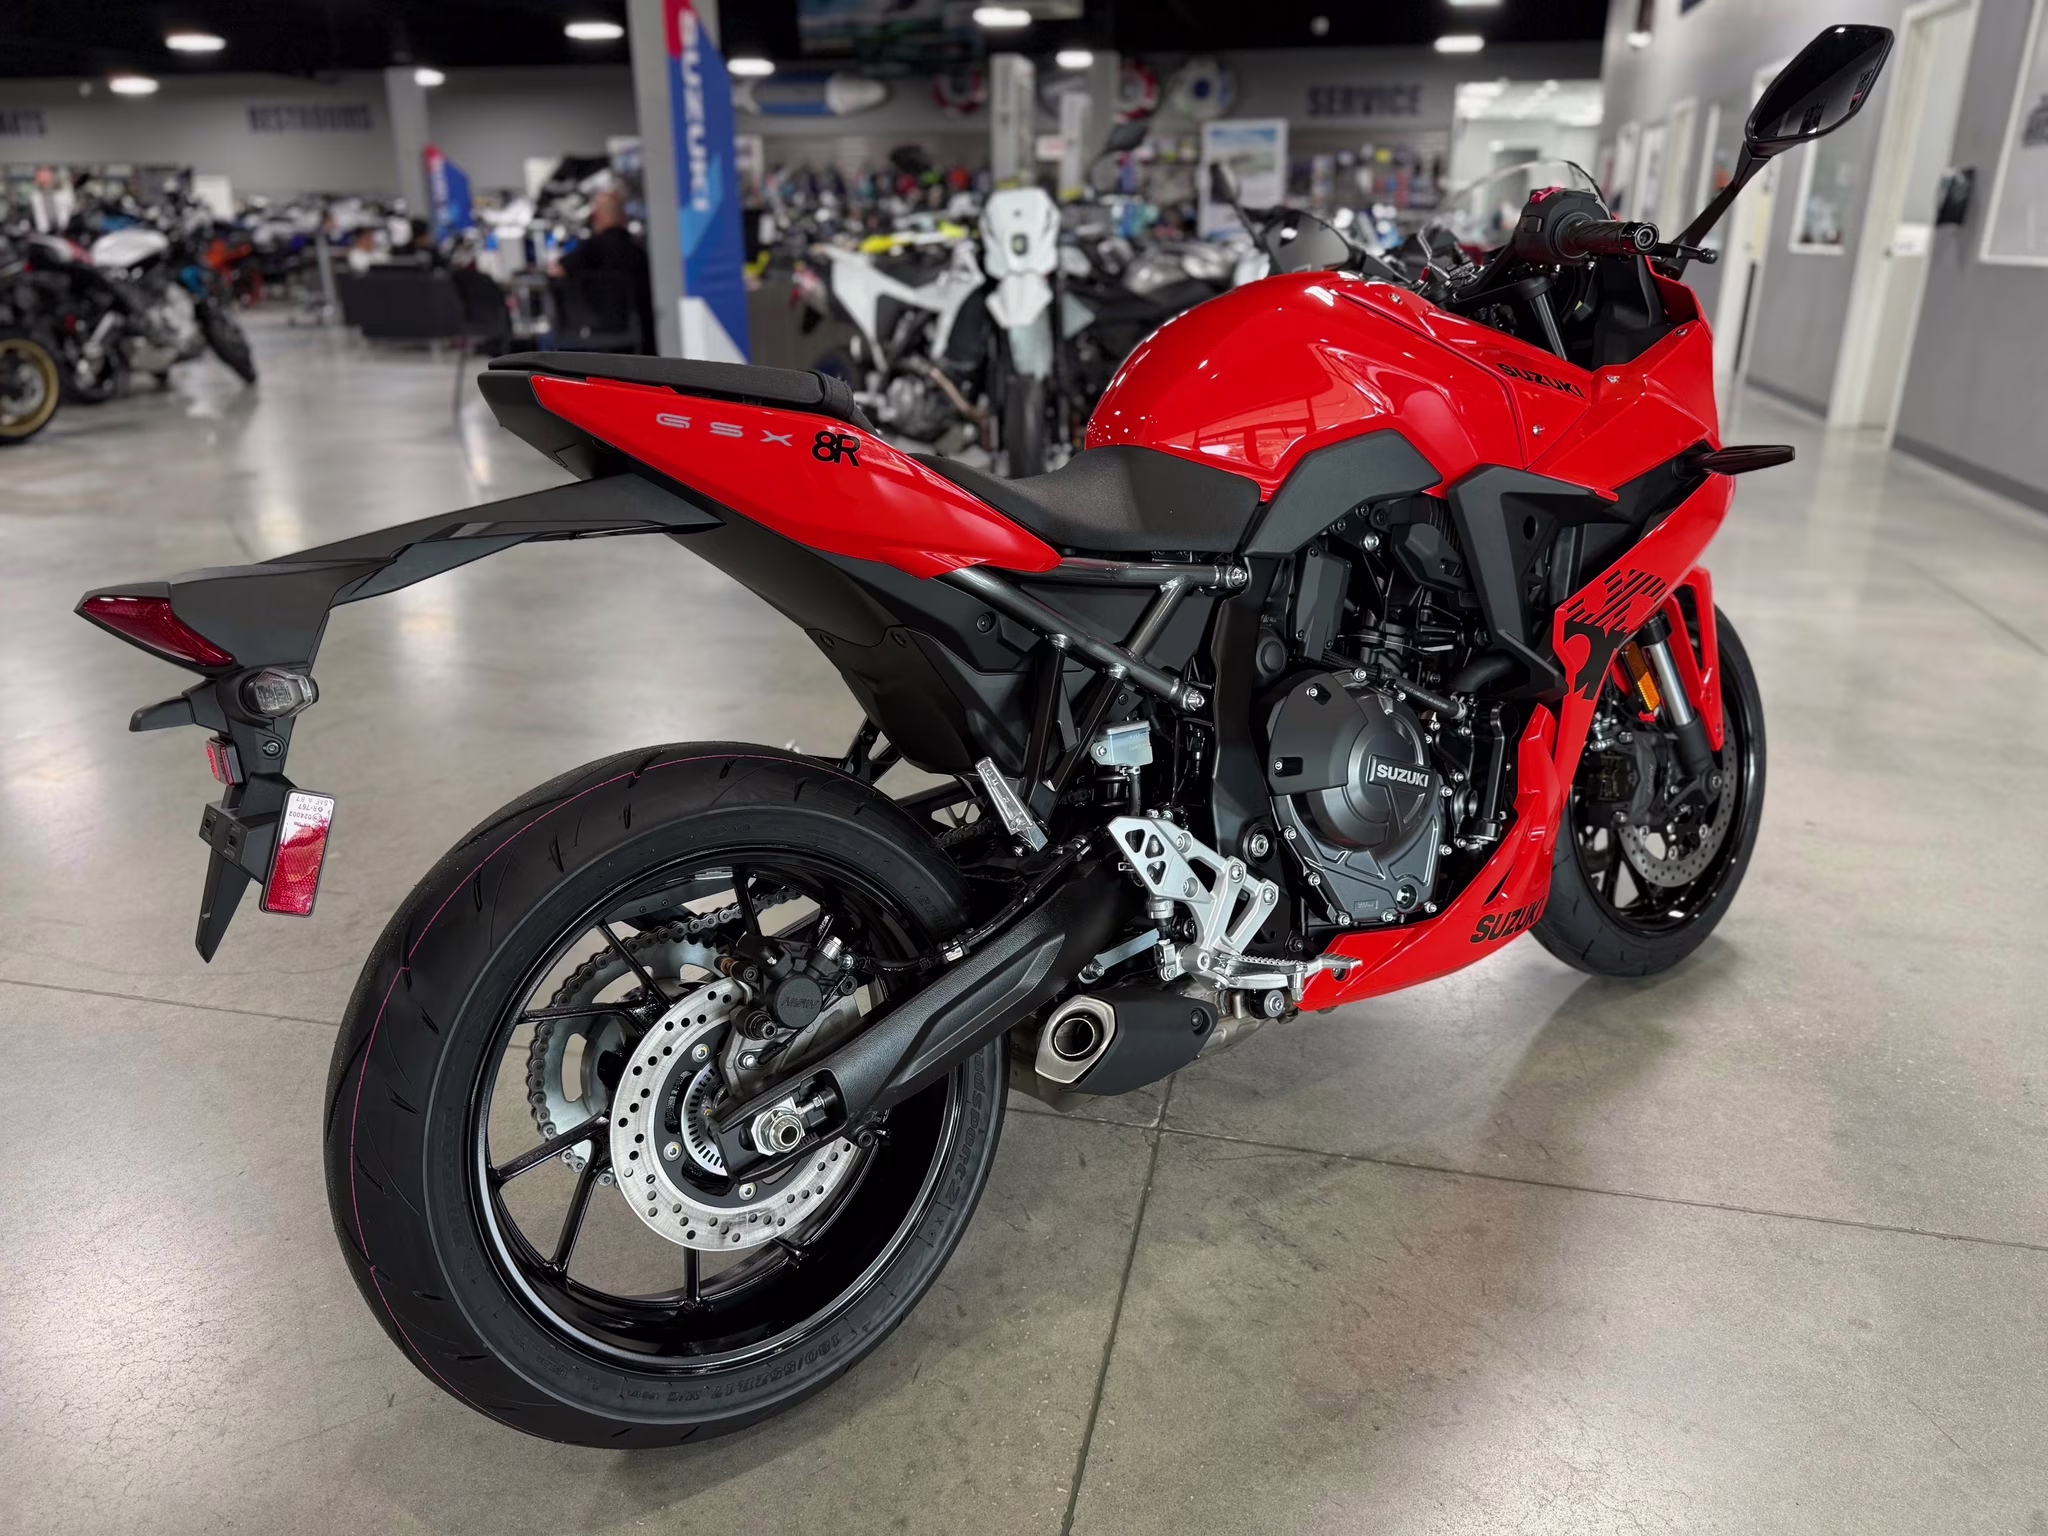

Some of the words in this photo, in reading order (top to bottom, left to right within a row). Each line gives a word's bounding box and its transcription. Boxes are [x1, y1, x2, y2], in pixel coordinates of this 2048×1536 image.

[679, 8, 710, 212] SUZUKI
[1307, 83, 1421, 117] SERVICE
[1497, 363, 1585, 398] SUZUKI
[811, 430, 860, 467] 8R
[1376, 763, 1429, 787] SUZUKI
[1470, 896, 1545, 943] SUZUKI
